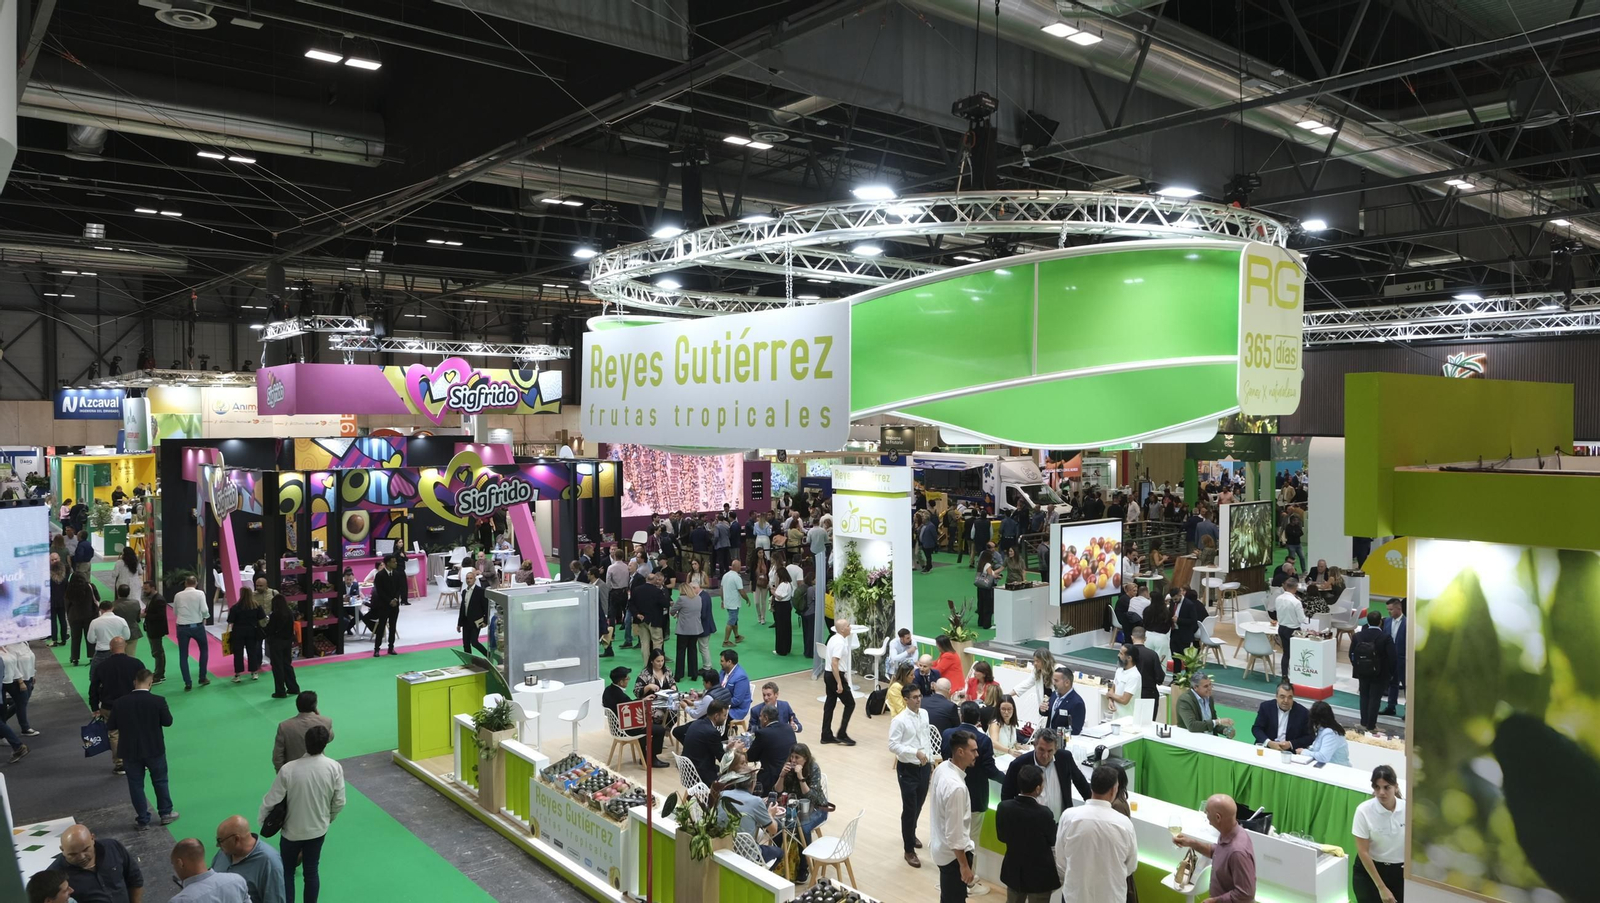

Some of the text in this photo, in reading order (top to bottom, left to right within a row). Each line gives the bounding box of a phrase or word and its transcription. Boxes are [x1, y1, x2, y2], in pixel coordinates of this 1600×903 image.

[1246, 254, 1300, 309] RG
[590, 327, 833, 400] Reyes Gutiérrez
[1244, 332, 1296, 369] 365 días
[79, 396, 119, 408] Azcaval
[449, 383, 518, 412] Sigfrido
[590, 399, 831, 434] frutas tropicales
[458, 478, 531, 516] Sigfrido
[859, 516, 887, 535] RG
[535, 784, 614, 848] Reyes Gutiérrez
[535, 808, 613, 863] frutas tropicales
